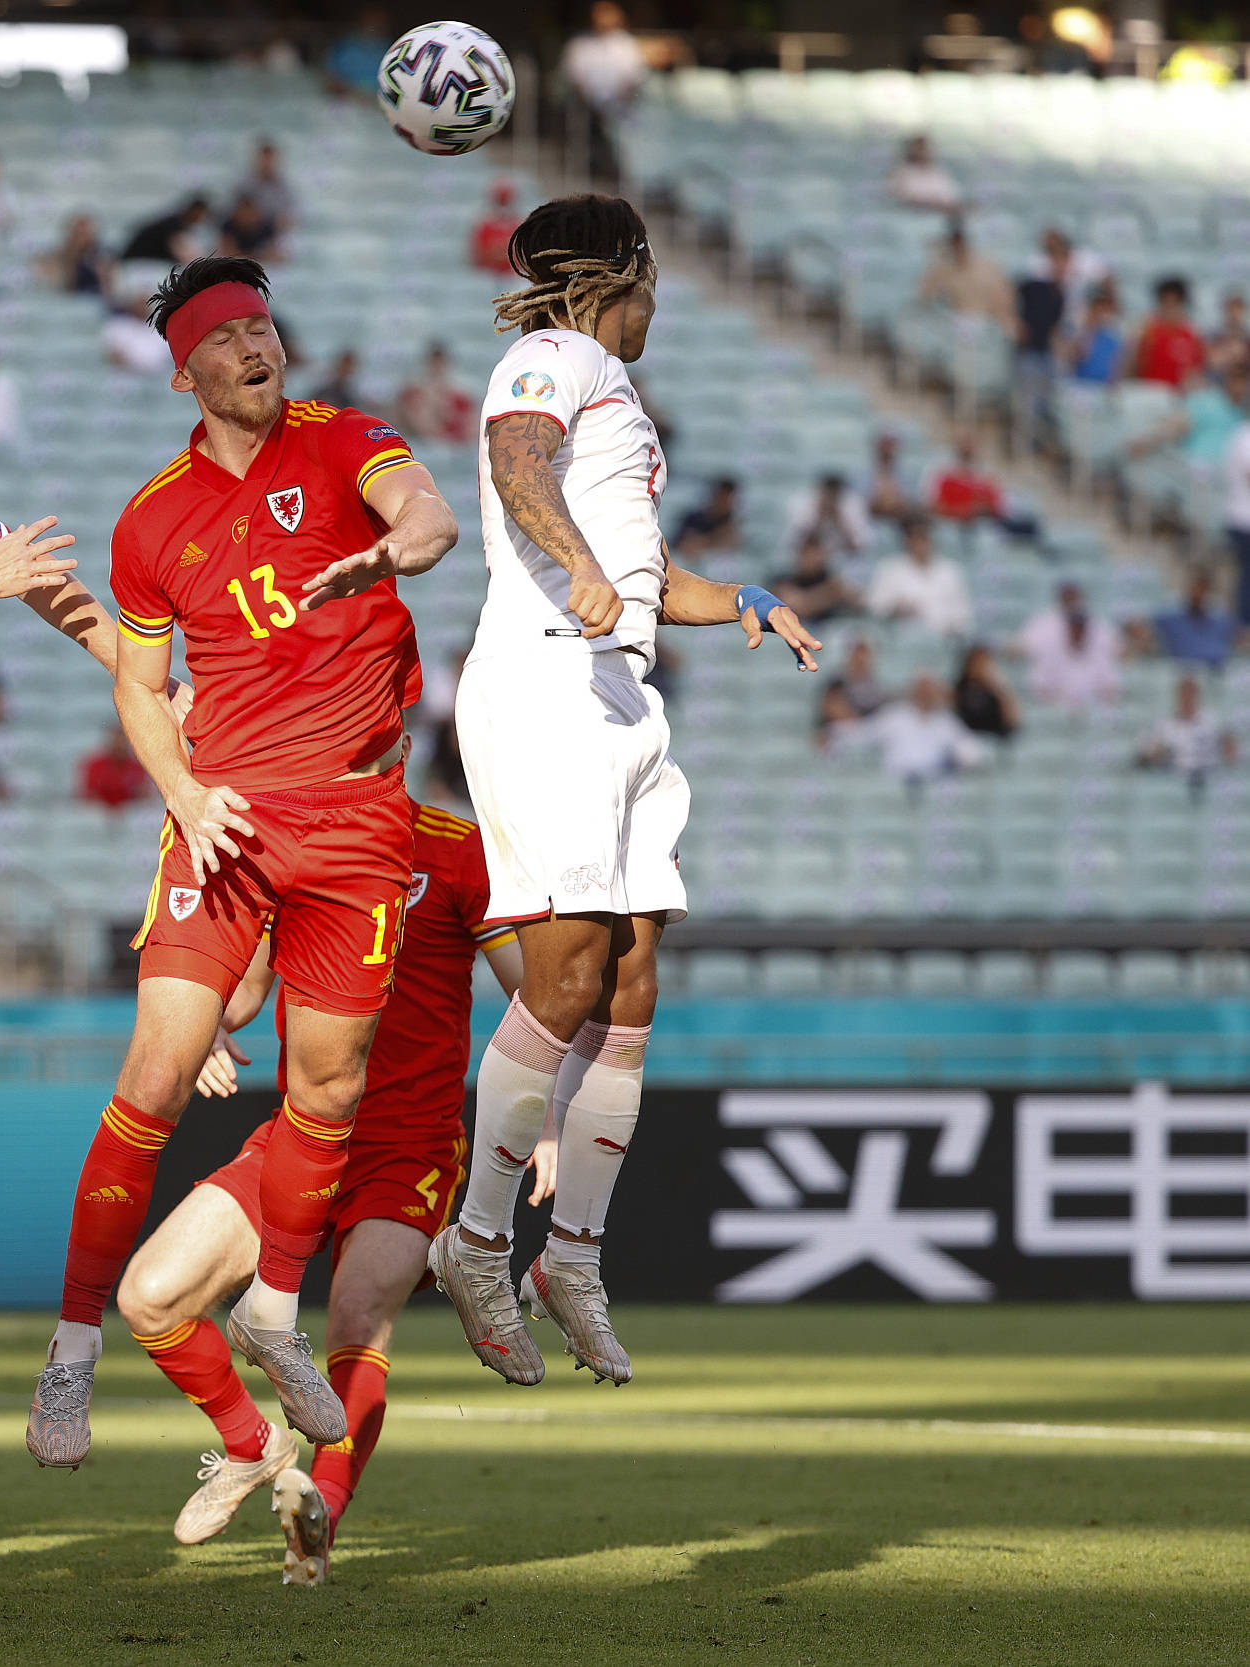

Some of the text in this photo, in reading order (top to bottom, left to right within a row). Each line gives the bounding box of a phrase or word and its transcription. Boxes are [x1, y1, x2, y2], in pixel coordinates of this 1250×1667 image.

[226, 563, 297, 640] 13
[84, 1195, 134, 1205] adidas
[709, 1080, 1250, 1302] 买电
